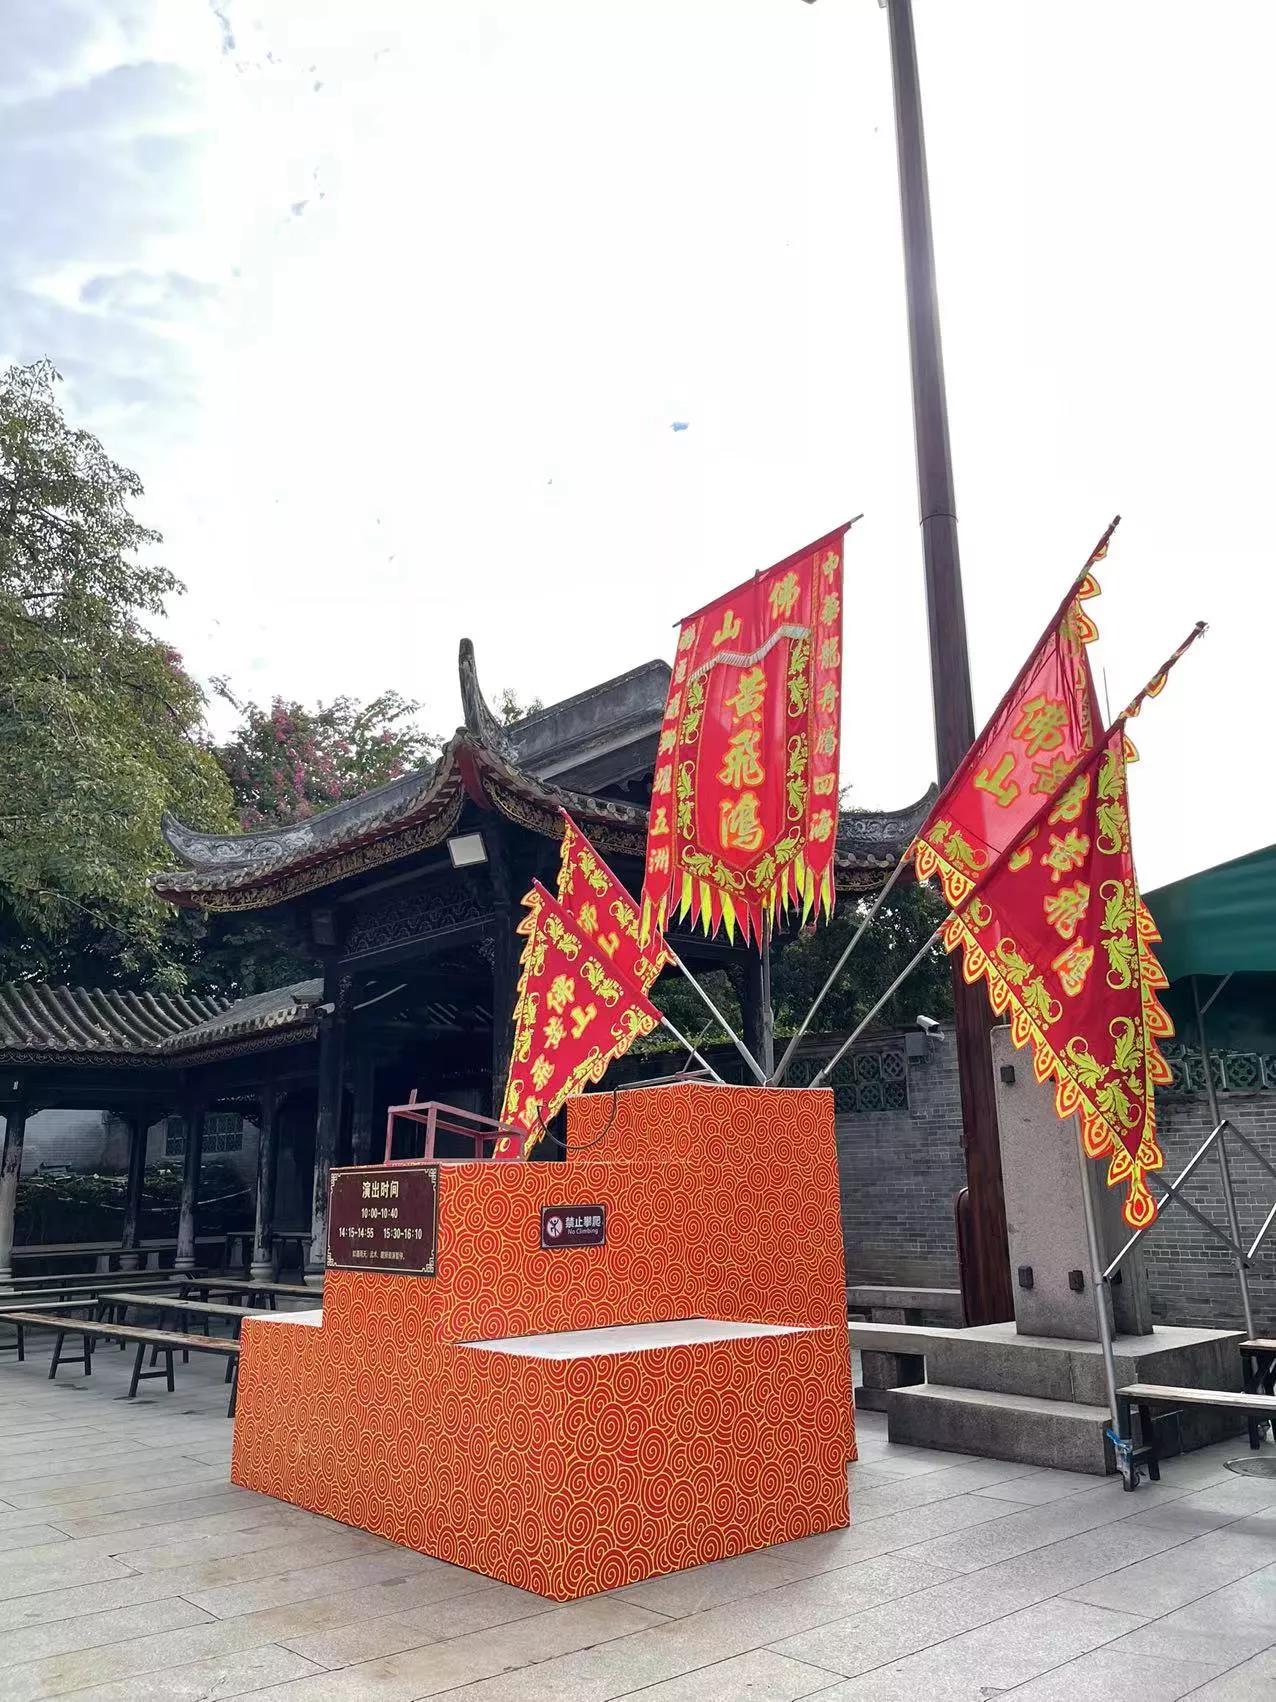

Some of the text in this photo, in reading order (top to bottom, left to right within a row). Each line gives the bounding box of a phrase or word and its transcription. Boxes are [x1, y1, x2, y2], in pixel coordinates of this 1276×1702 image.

[361, 1180, 399, 1199] 演出时间
[361, 1207, 399, 1219] 10:00-10:40
[565, 1215, 602, 1229] 禁止攀爬
[338, 1227, 423, 1240] 14:15-14:55 15:30-16:10
